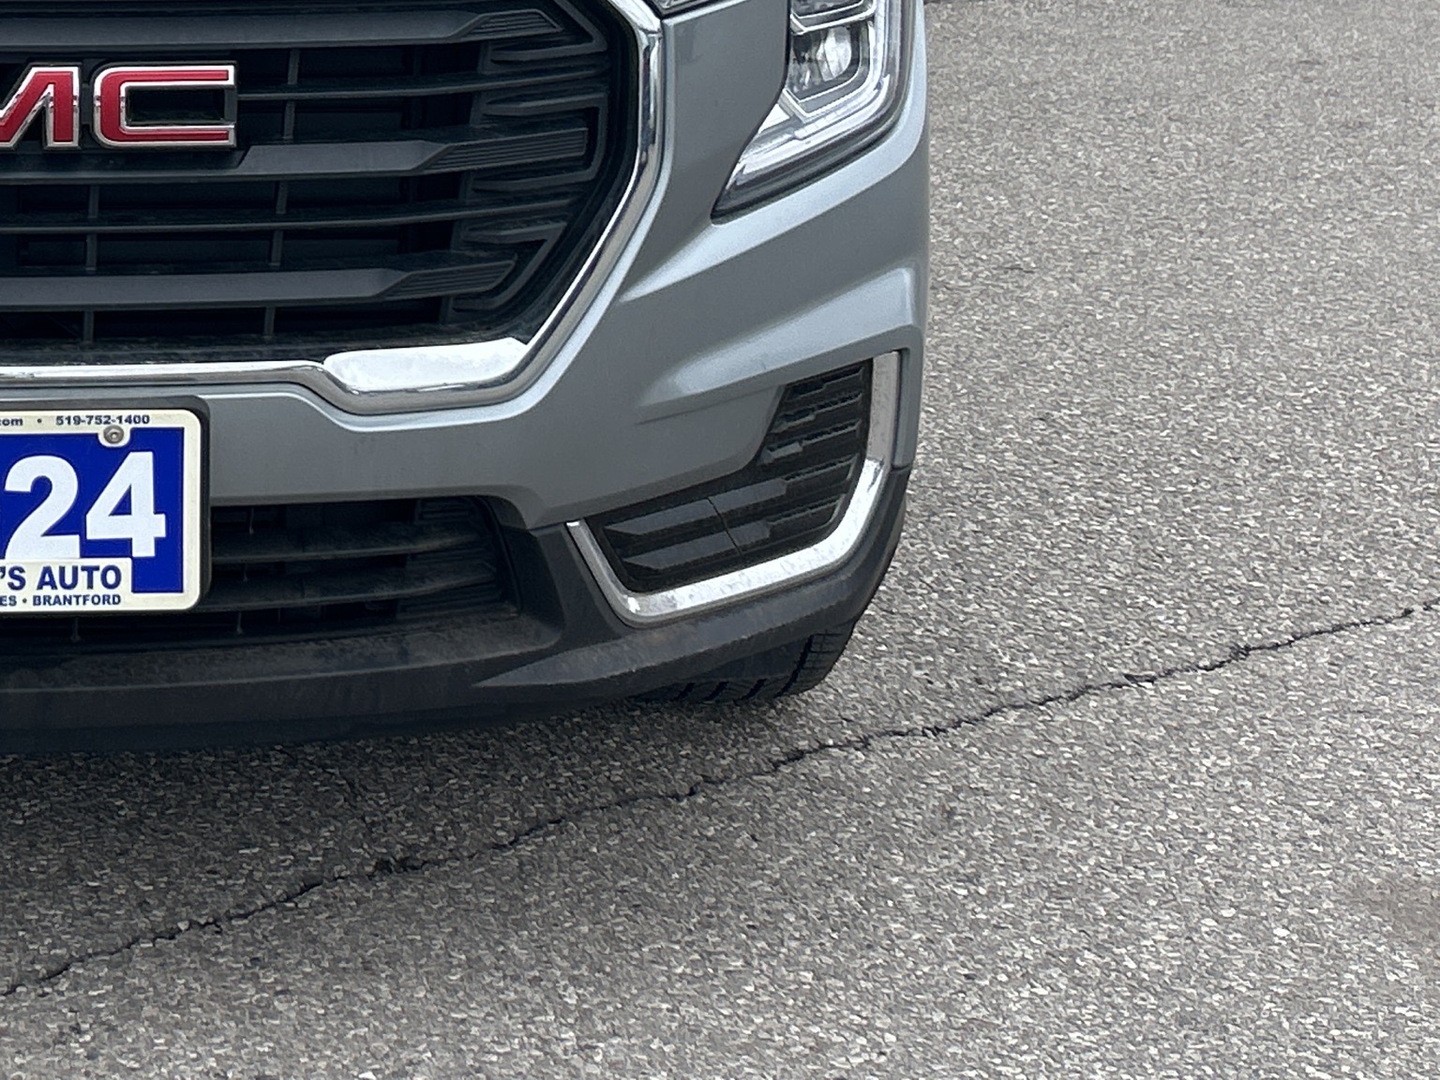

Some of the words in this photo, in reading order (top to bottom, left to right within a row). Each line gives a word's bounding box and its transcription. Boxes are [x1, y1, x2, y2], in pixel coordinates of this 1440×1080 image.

[55, 414, 151, 426] 519-752-1400
[36, 564, 122, 591] AUTO
[32, 594, 122, 606] BRANTFORD
